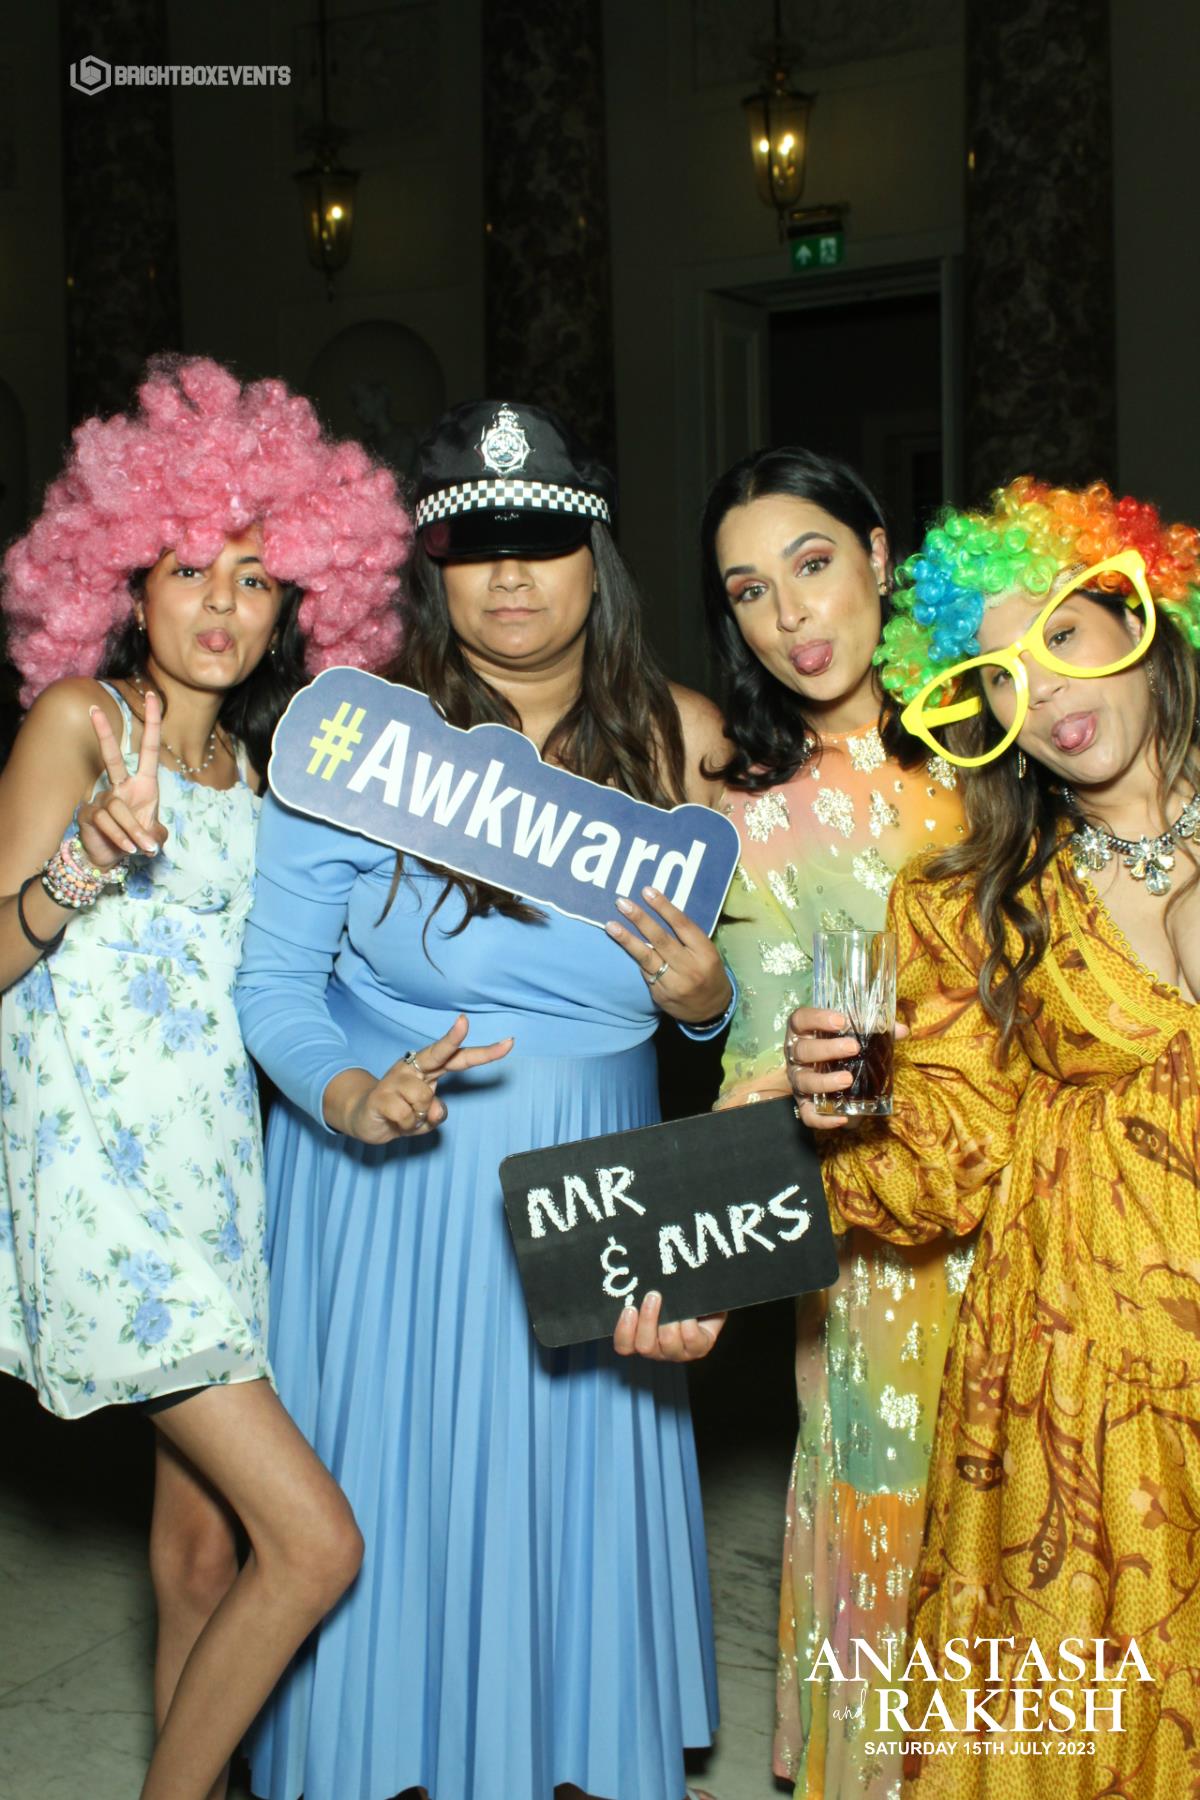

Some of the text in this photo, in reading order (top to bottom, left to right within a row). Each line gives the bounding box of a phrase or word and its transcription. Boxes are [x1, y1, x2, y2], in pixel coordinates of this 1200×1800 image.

[306, 701, 707, 912] #Awkward
[527, 1165, 647, 1239] MR
[600, 1184, 814, 1307] & MRS
